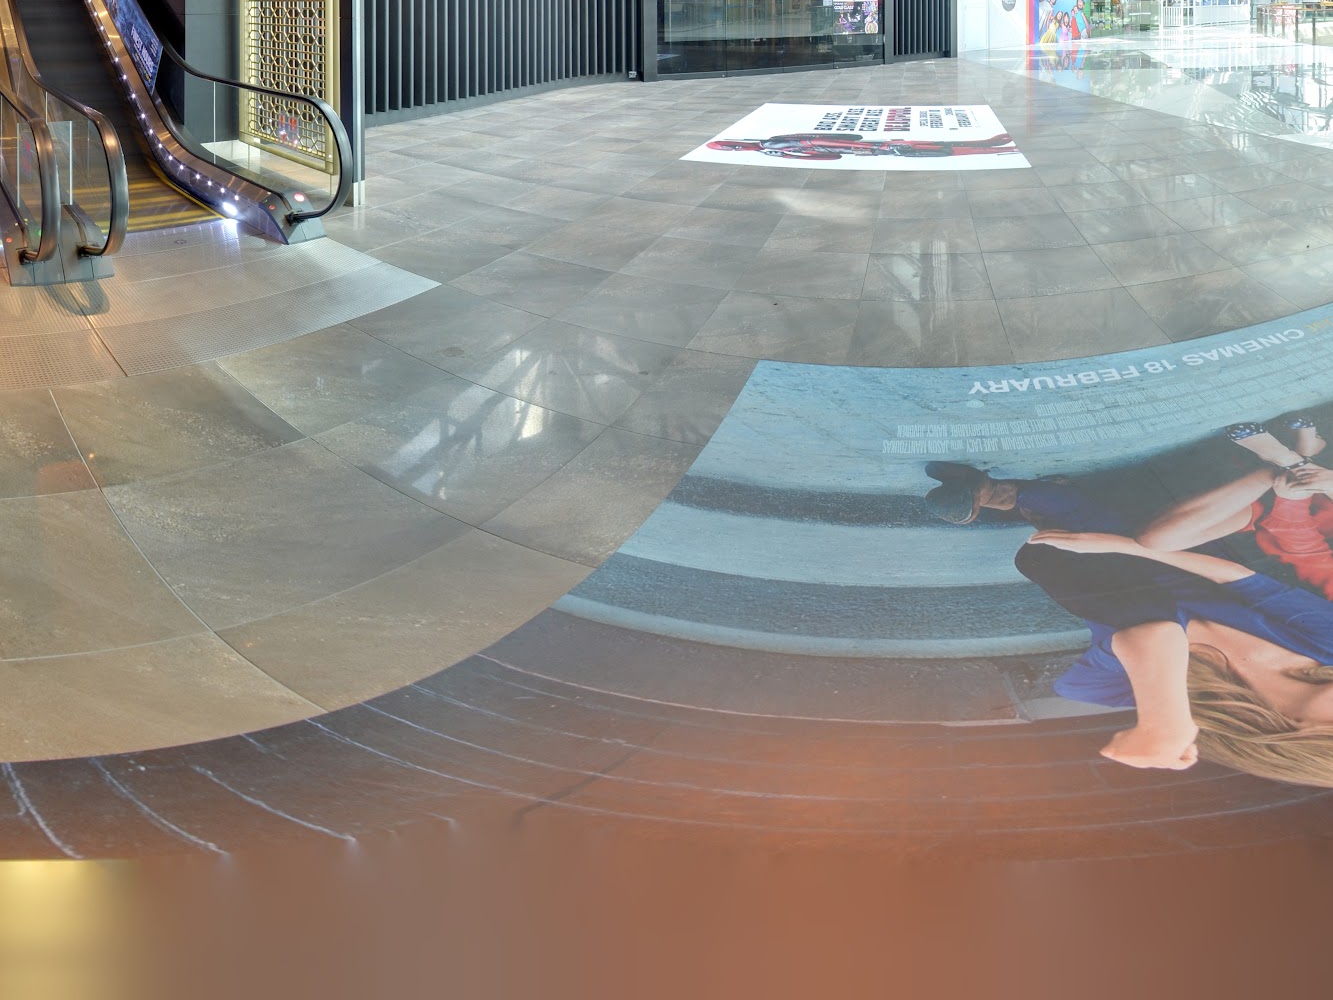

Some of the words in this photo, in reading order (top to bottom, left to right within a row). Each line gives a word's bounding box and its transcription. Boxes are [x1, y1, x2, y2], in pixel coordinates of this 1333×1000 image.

[1181, 327, 1305, 366] CINEMAS
[968, 365, 1141, 394] FEBRUARY
[1144, 359, 1177, 373] 18
